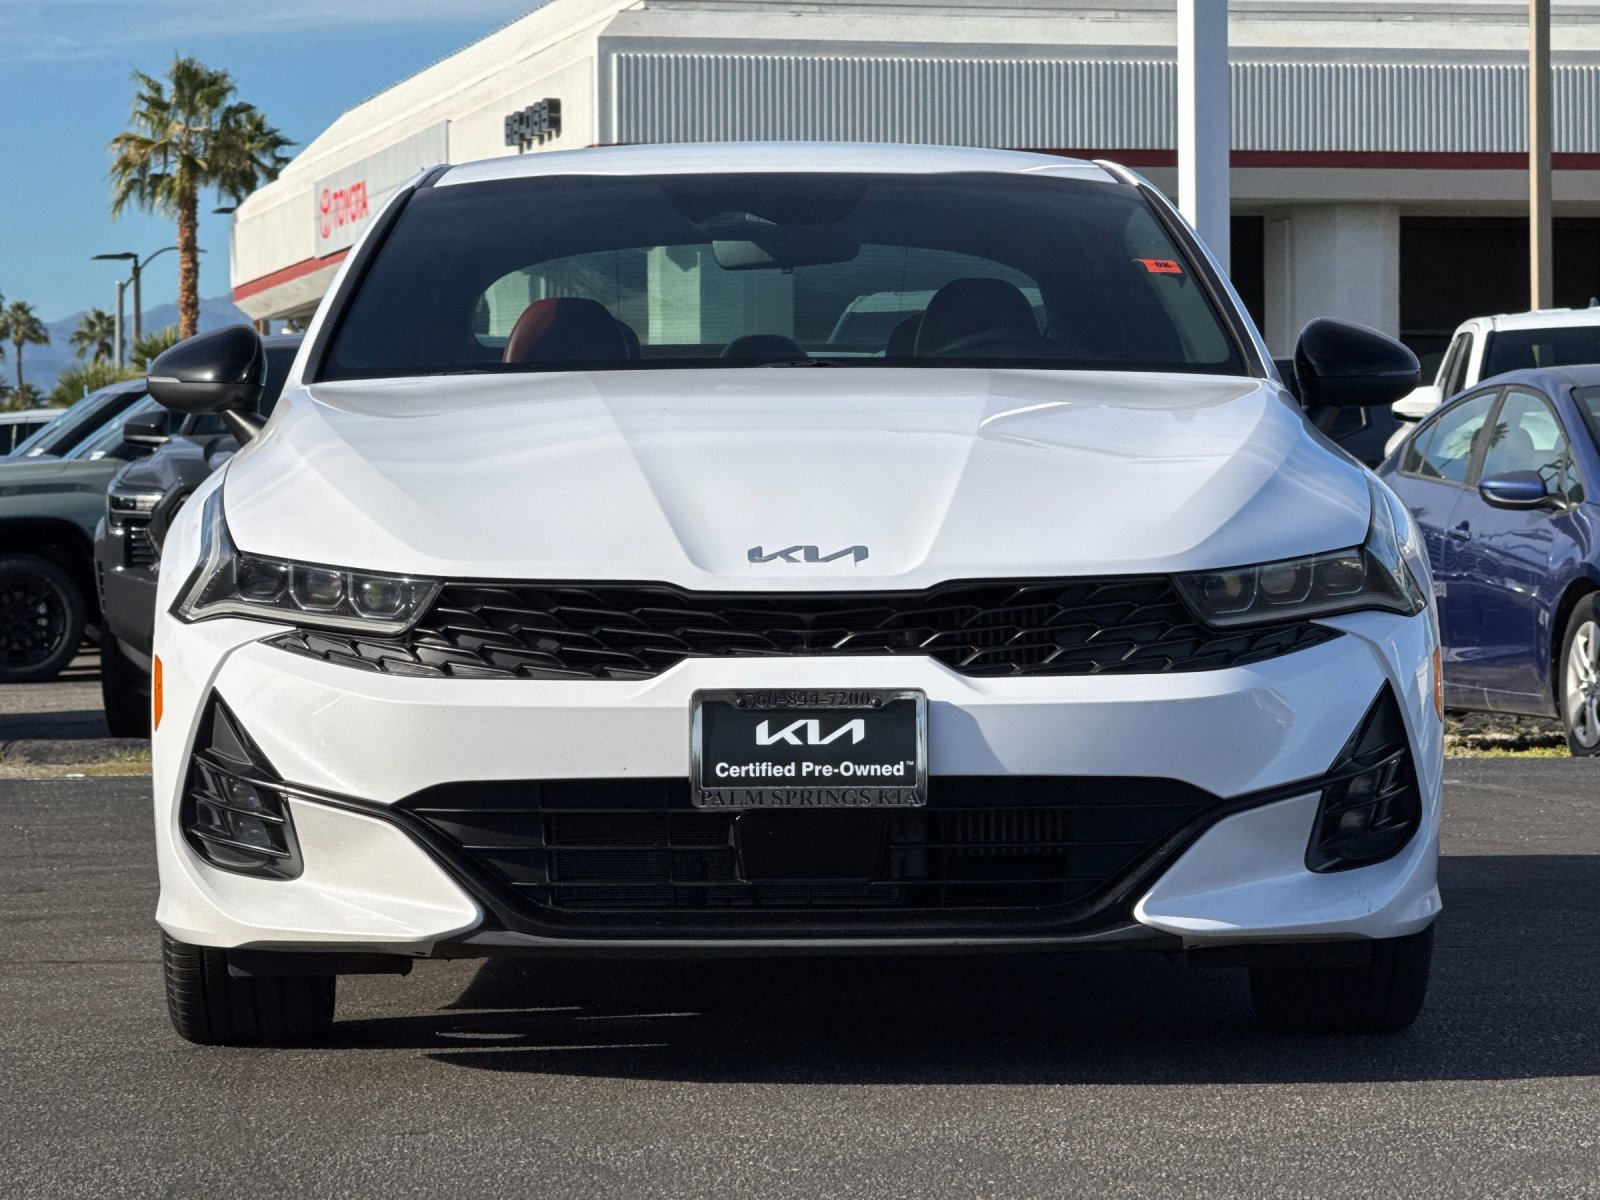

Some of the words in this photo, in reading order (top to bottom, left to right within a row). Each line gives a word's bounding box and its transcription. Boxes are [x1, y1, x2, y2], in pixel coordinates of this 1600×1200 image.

[332, 180, 368, 228] TOYOTA
[715, 761, 796, 778] Certified
[699, 789, 764, 806] PALM
[771, 788, 872, 807] SPRINGS
[878, 789, 921, 806] KIA
